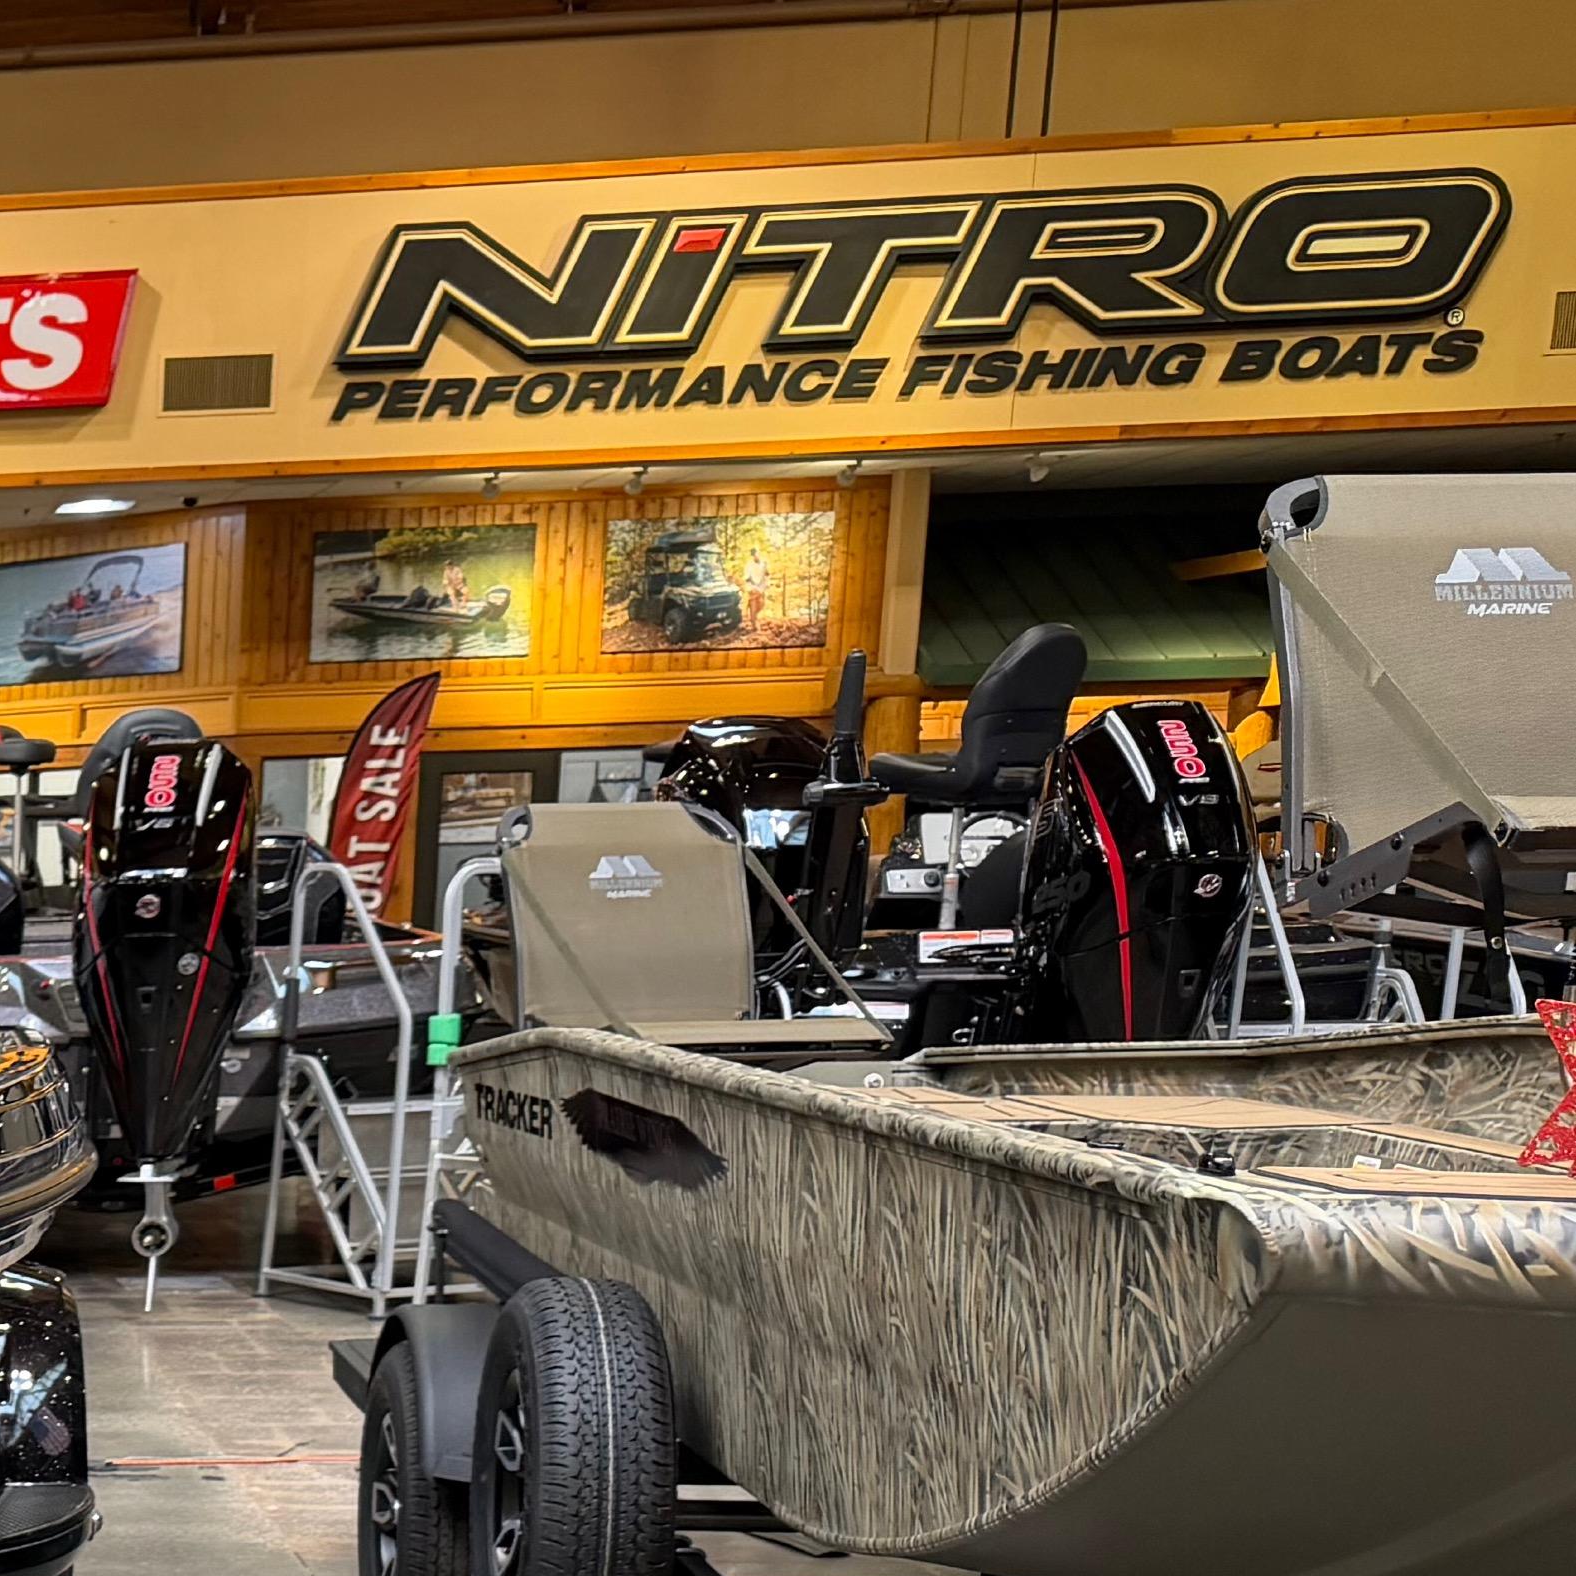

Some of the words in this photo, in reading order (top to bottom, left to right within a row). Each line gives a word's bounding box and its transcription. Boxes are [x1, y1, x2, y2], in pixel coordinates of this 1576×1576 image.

[334, 167, 1511, 370] NITRO
[329, 357, 890, 422] PERFORMANCE
[897, 342, 1206, 399] FISHING
[1220, 329, 1485, 383] BOATS
[1467, 603, 1553, 617] MARINE
[355, 724, 411, 823] SALE
[474, 1083, 554, 1140] TRACKER
